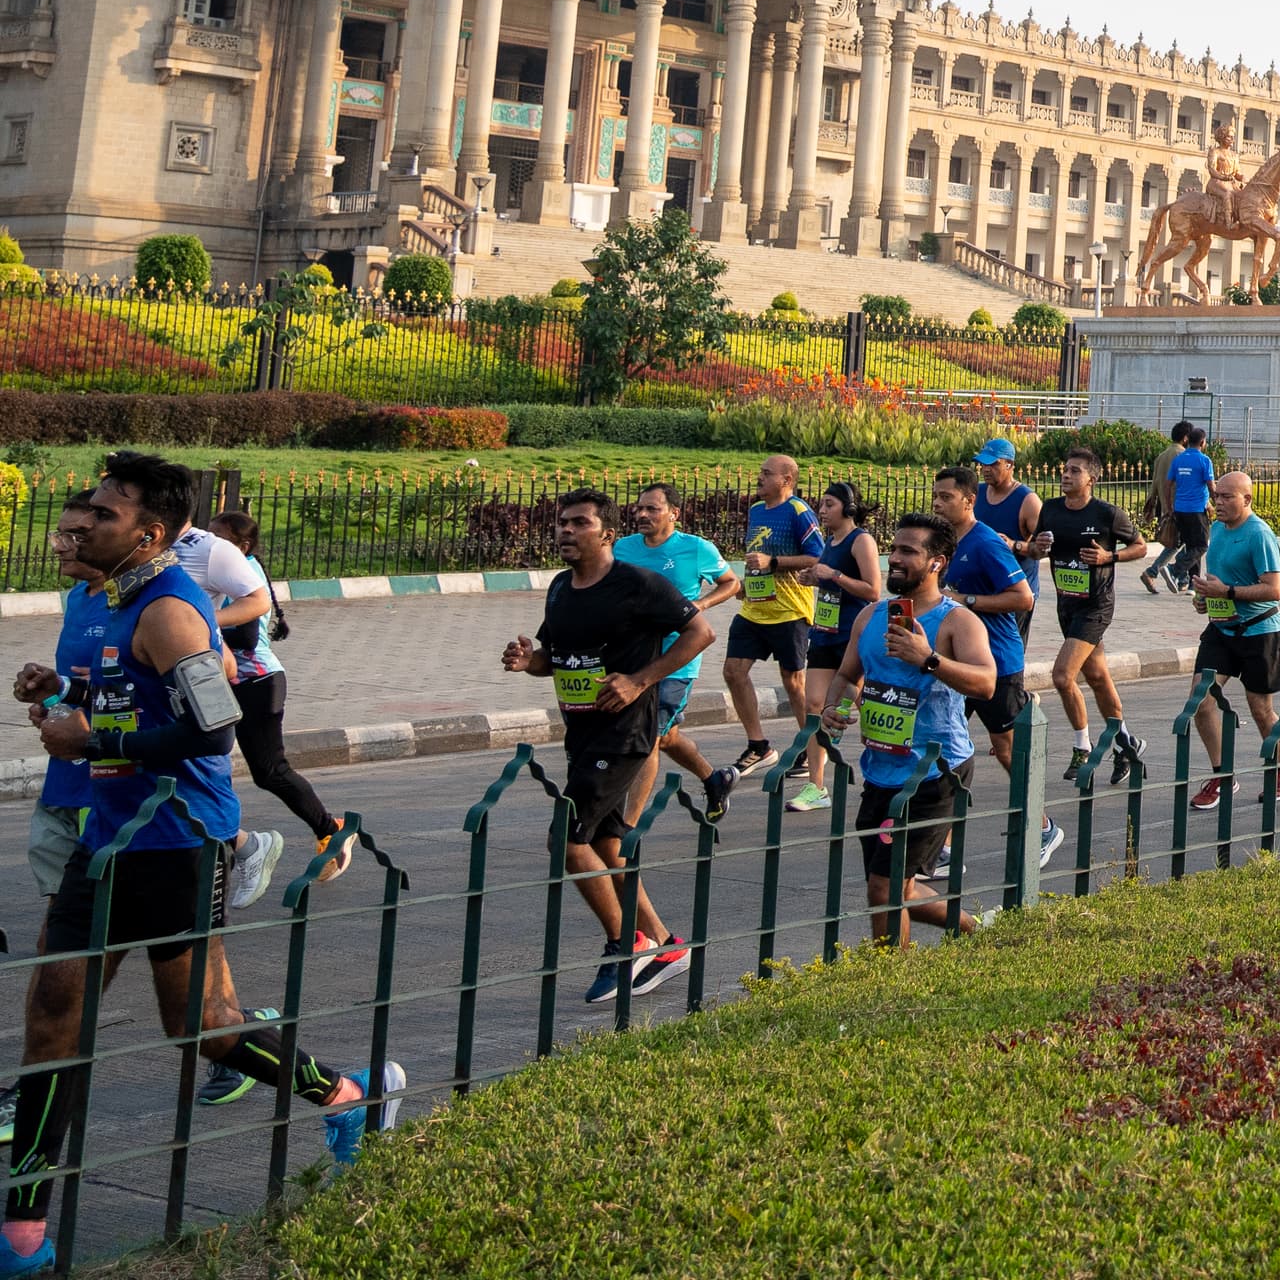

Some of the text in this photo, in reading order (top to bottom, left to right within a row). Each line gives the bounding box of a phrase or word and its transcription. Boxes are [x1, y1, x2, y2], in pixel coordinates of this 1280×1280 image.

[1060, 573, 1084, 585] 10594
[1208, 599, 1229, 610] 10683
[560, 677, 593, 692] 3402
[864, 709, 905, 732] 16602
